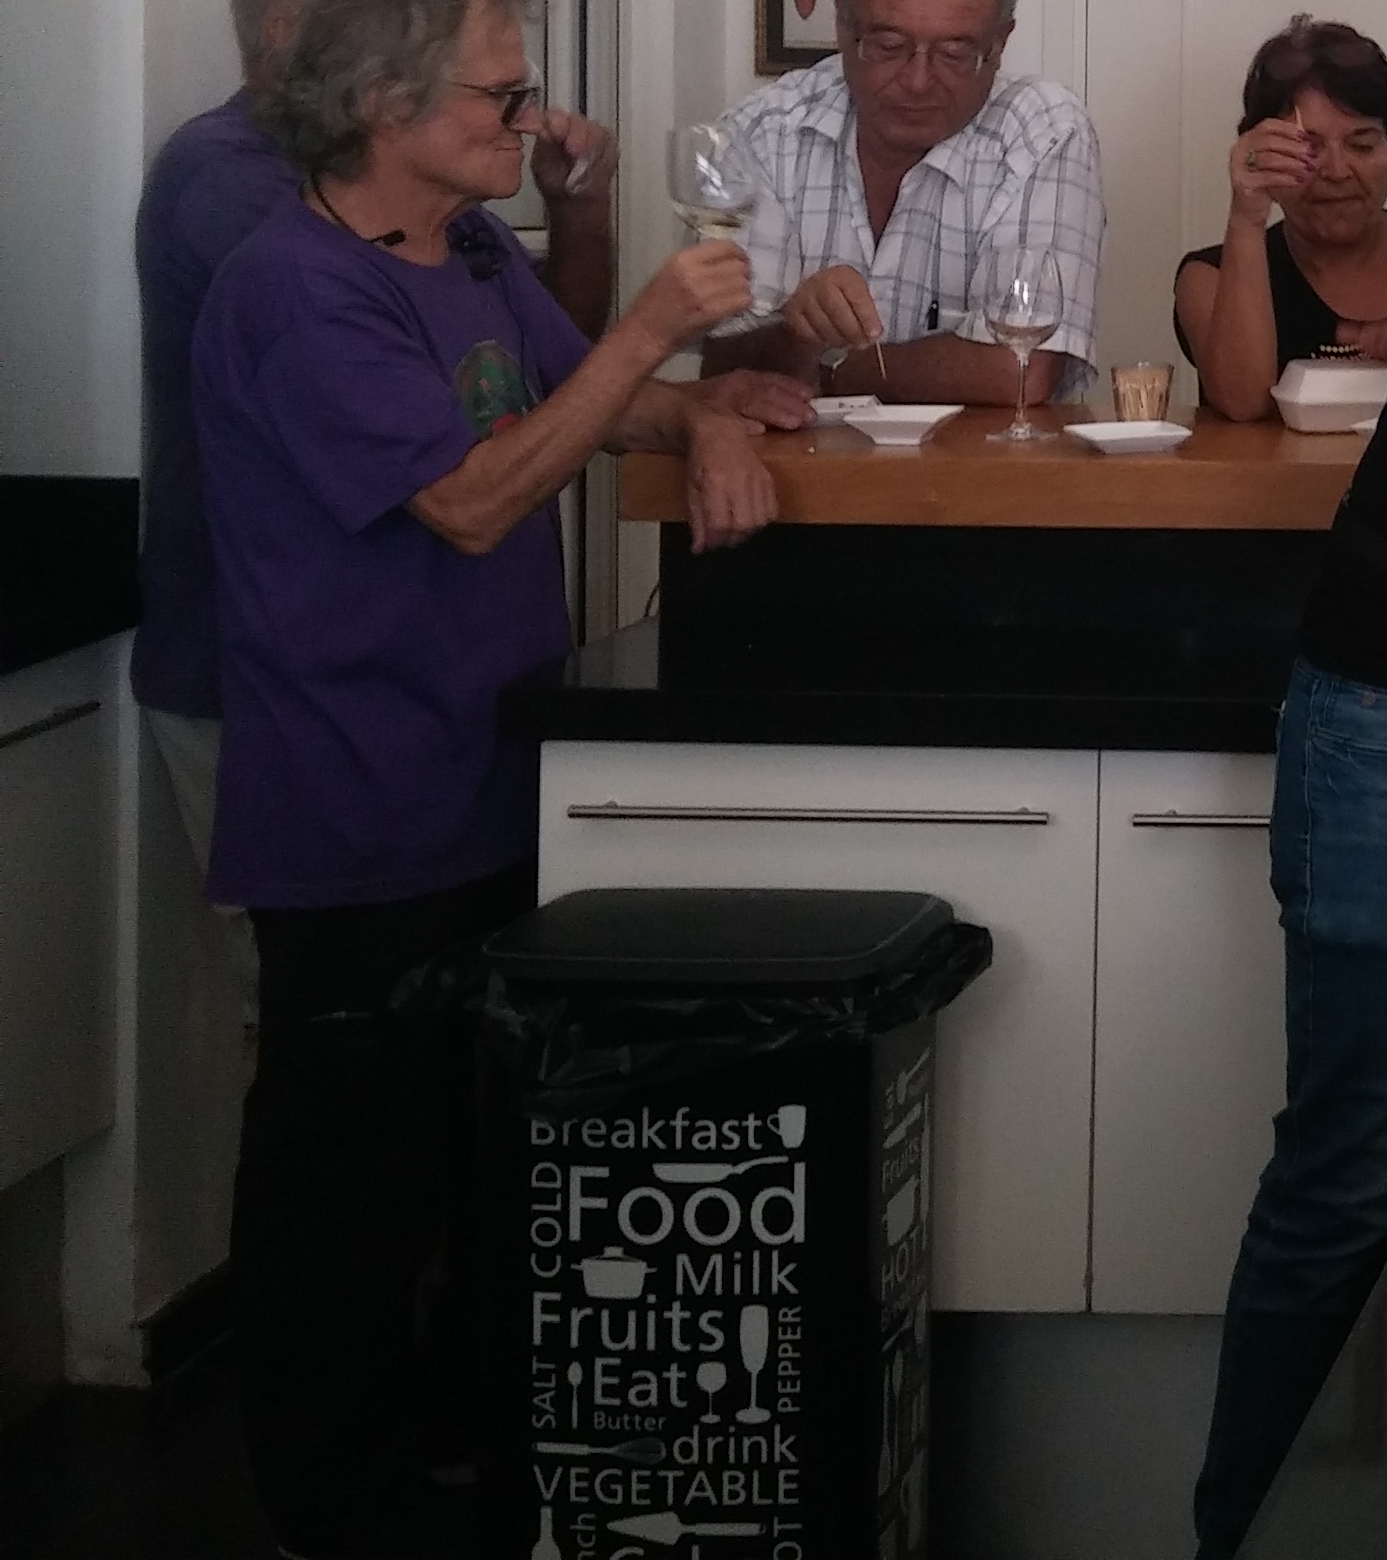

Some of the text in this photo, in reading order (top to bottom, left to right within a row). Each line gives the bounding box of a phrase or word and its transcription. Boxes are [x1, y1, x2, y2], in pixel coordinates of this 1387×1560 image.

[531, 1106, 763, 1151] Breakfast
[529, 1161, 563, 1279] COLD
[568, 1160, 806, 1247] Food
[675, 1251, 800, 1297] Milk
[533, 1292, 726, 1353] Fruits
[593, 1357, 689, 1408] Eat
[778, 1305, 803, 1413] PEPPER
[532, 1357, 557, 1429] SALT
[593, 1411, 666, 1431] Butter
[673, 1425, 798, 1465] drink
[534, 1465, 800, 1506] VEGETABLE
